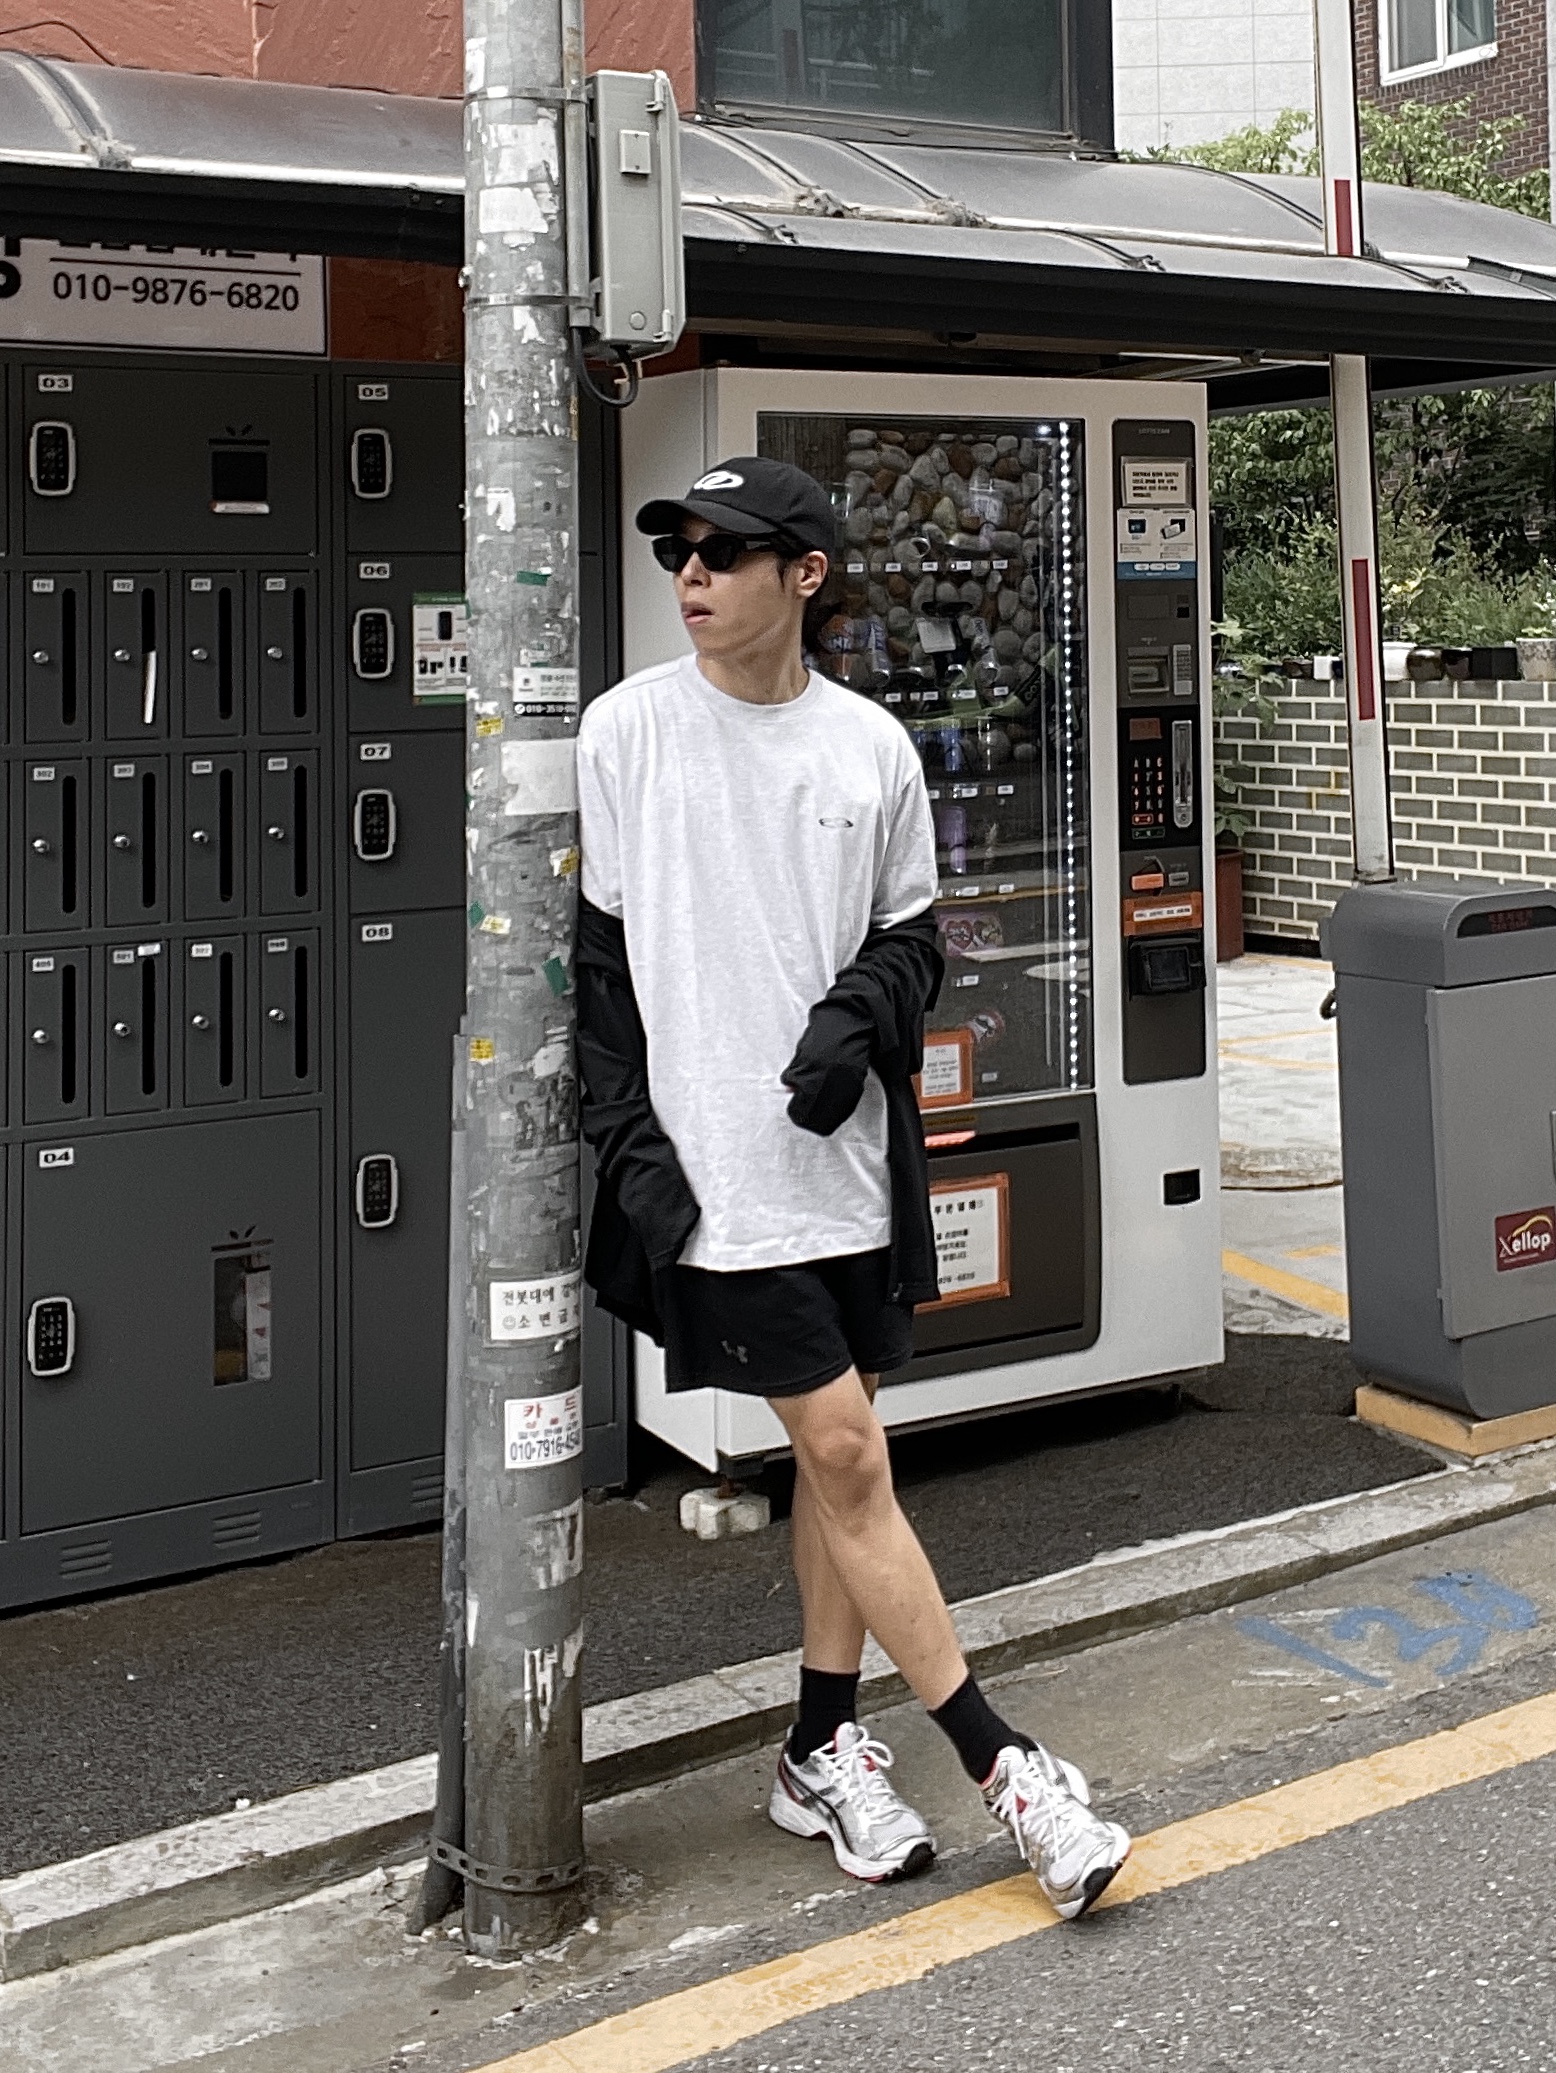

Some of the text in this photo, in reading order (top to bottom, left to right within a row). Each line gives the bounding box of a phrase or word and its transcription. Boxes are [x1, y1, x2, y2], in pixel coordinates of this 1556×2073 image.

[52, 271, 300, 312] 010-9876-6820
[42, 376, 70, 390] 03
[360, 386, 388, 399] 05
[362, 564, 389, 577] 06
[362, 745, 389, 758] 07
[364, 925, 392, 939] 08
[42, 1150, 72, 1165] 04
[1498, 1230, 1551, 1257] Xellop
